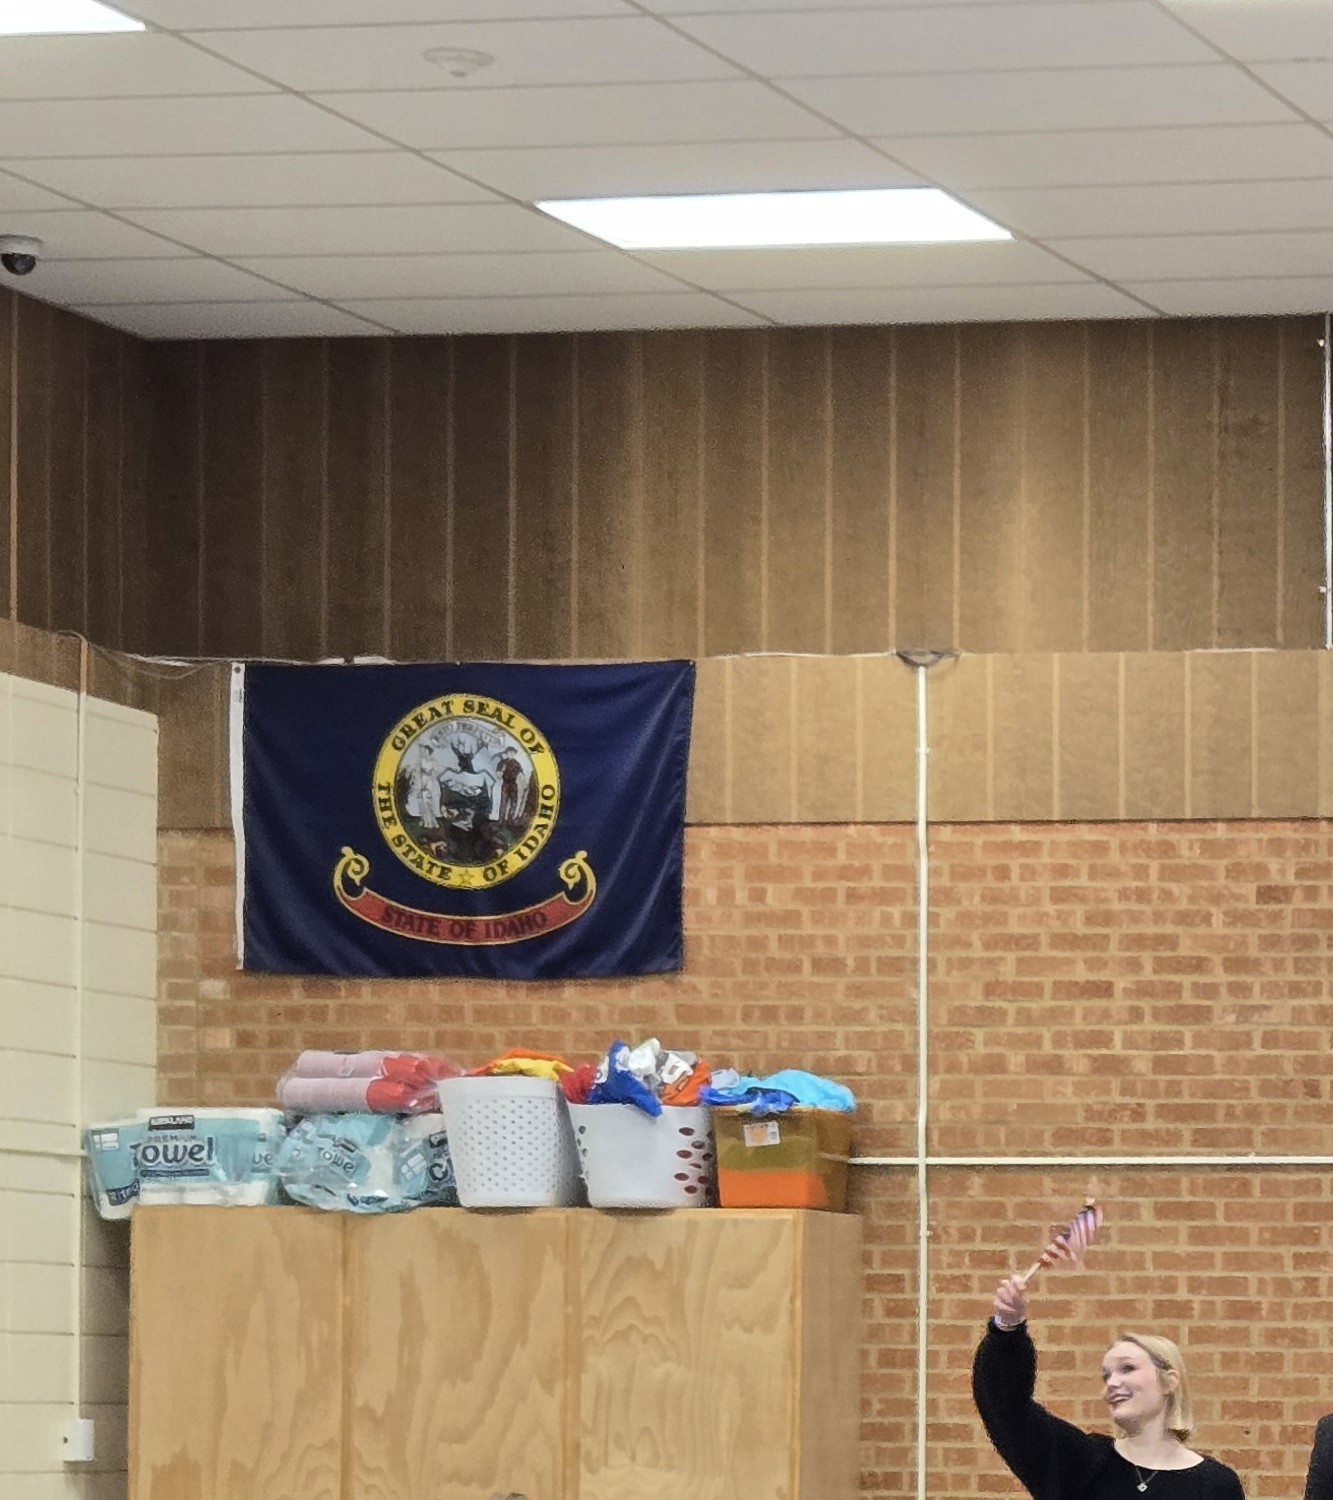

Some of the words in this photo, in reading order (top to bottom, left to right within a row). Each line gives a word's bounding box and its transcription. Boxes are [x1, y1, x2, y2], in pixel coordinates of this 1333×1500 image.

[392, 699, 453, 751] GREAT
[463, 699, 515, 730] SEAL
[521, 728, 545, 755] OF
[378, 781, 397, 829] THE
[392, 834, 453, 880] STATE
[483, 859, 509, 881] OF
[513, 784, 555, 861] IDAHO
[382, 904, 442, 936] STATE
[450, 920, 476, 938] OF
[485, 911, 548, 938] IDAHO
